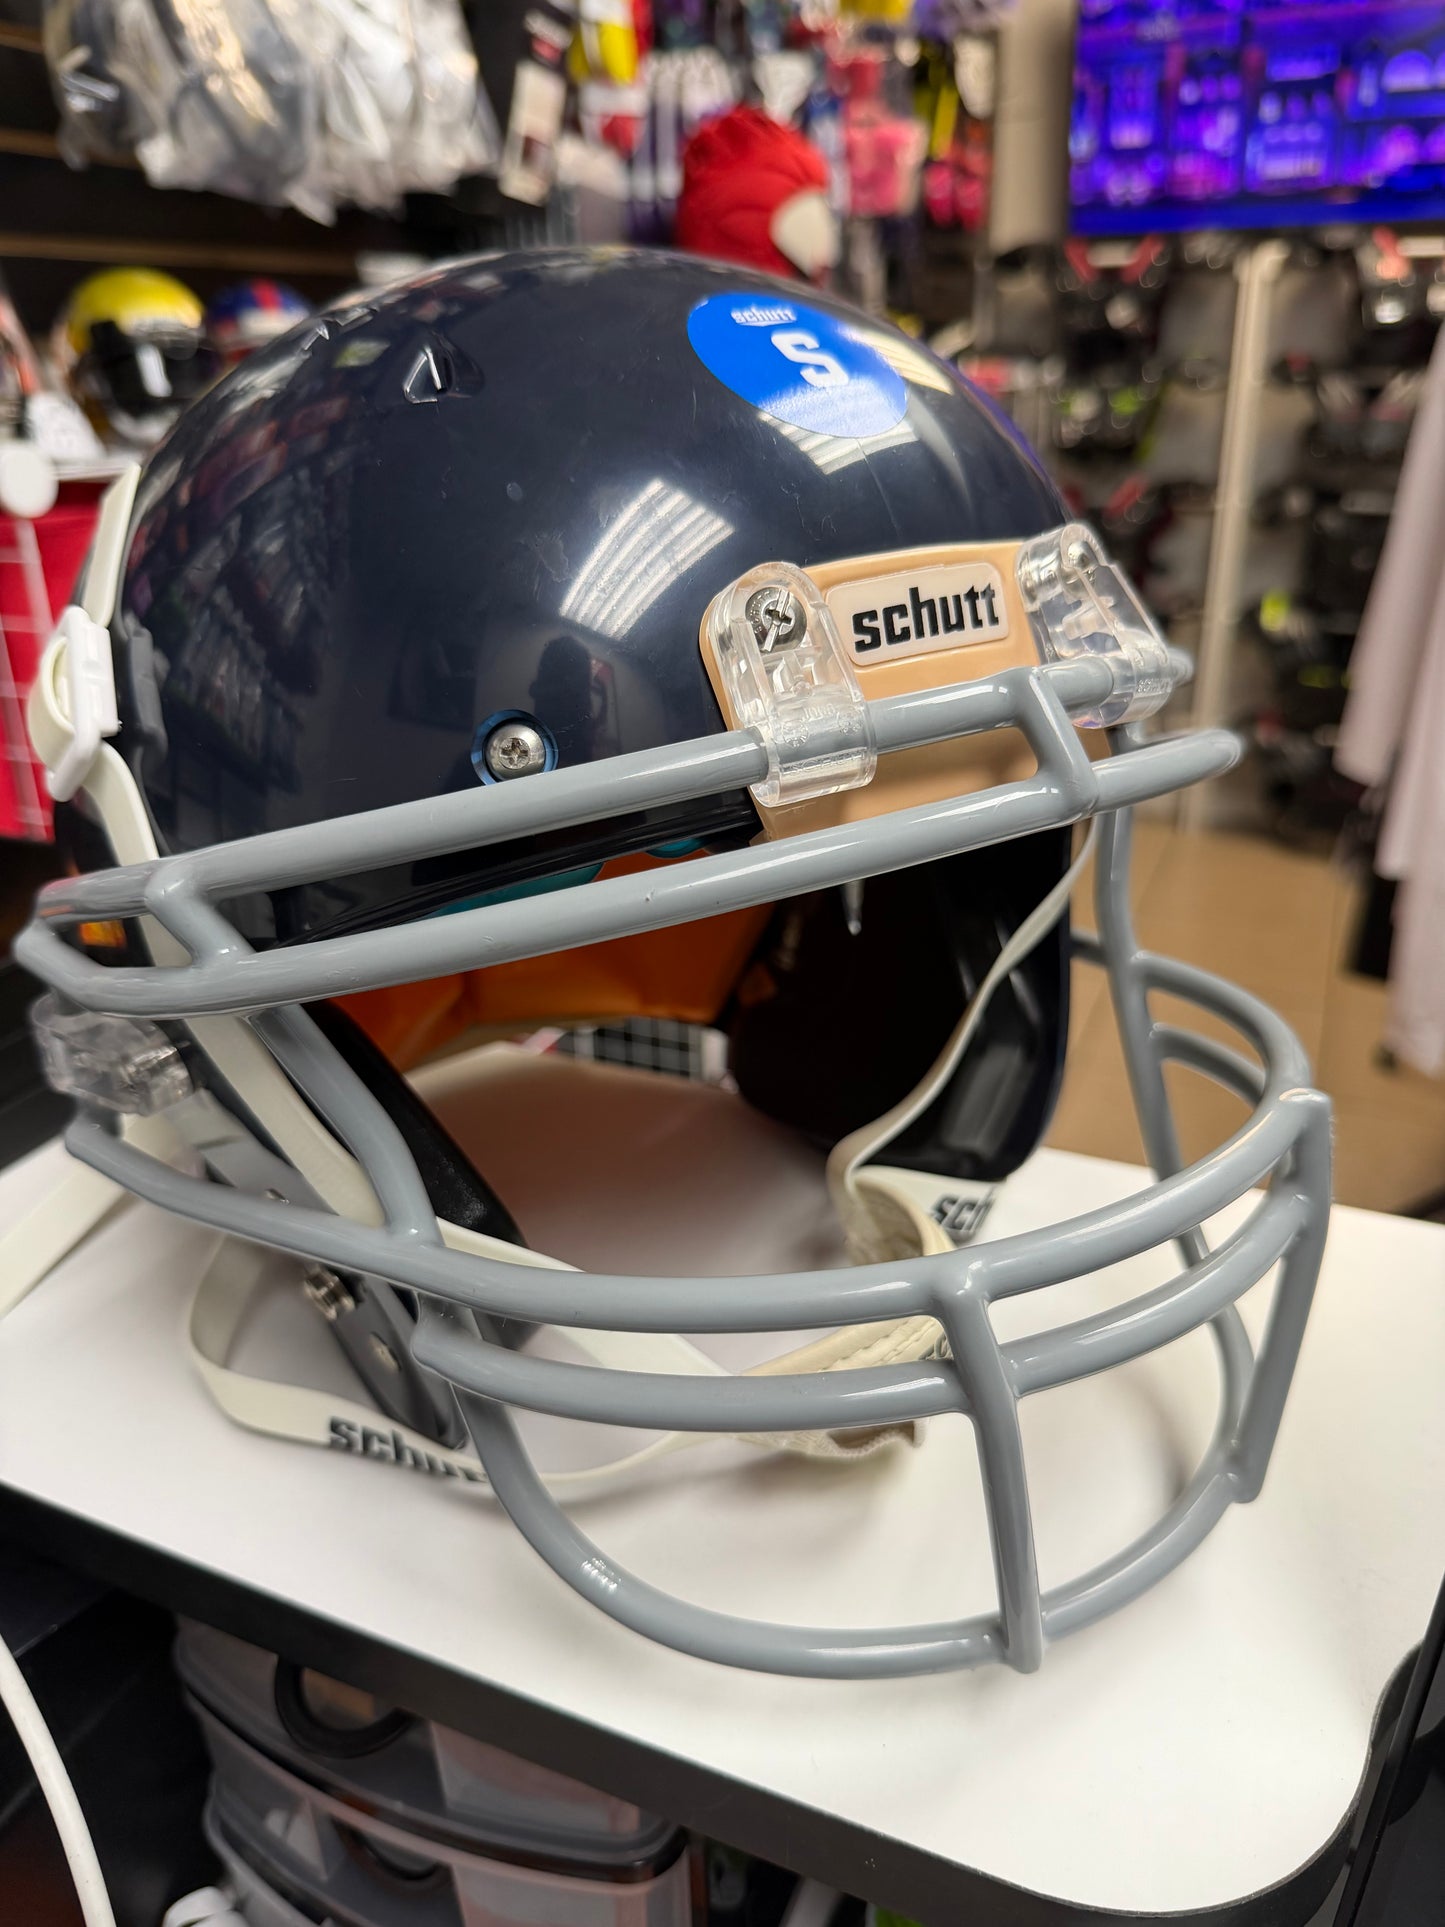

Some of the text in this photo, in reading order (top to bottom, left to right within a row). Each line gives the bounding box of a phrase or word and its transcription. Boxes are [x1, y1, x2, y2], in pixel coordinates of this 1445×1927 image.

[730, 307, 797, 323] schutt
[771, 333, 849, 388] S
[852, 583, 999, 654] schutt
